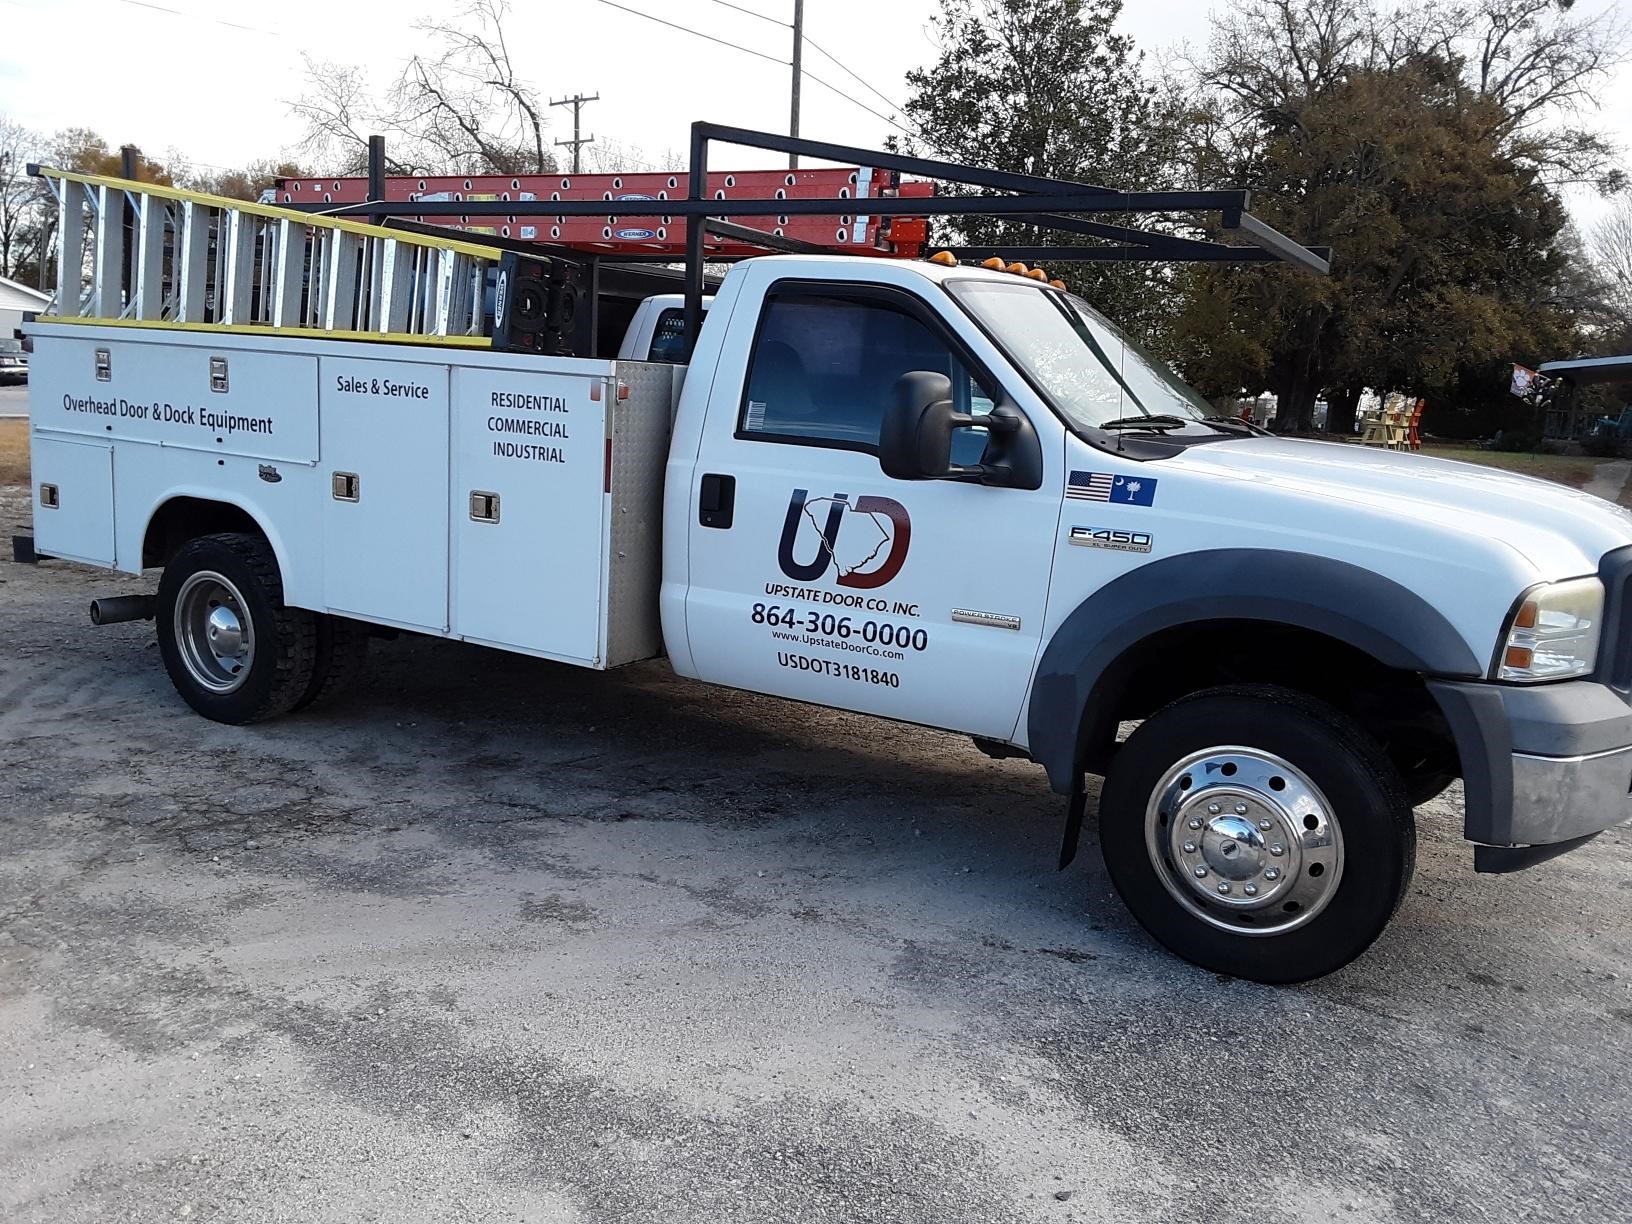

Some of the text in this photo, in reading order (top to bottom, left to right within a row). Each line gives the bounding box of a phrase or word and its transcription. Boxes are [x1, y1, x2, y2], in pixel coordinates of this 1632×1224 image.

[337, 376, 429, 400] Sales & Service
[63, 393, 273, 434] Overhead Door & Dock Equipment
[491, 391, 569, 413] RESIDENTIAL
[487, 416, 569, 439] COMMERCIAL
[493, 441, 566, 463] INDUSTRIAL
[1070, 527, 1150, 545] F-450
[765, 582, 921, 617] UPSTATE DOOR CO. INC.
[751, 603, 928, 651] 864-306-0000
[772, 630, 904, 661] www.UpstateDoorCo.com
[777, 652, 900, 688] USDOT3181840
